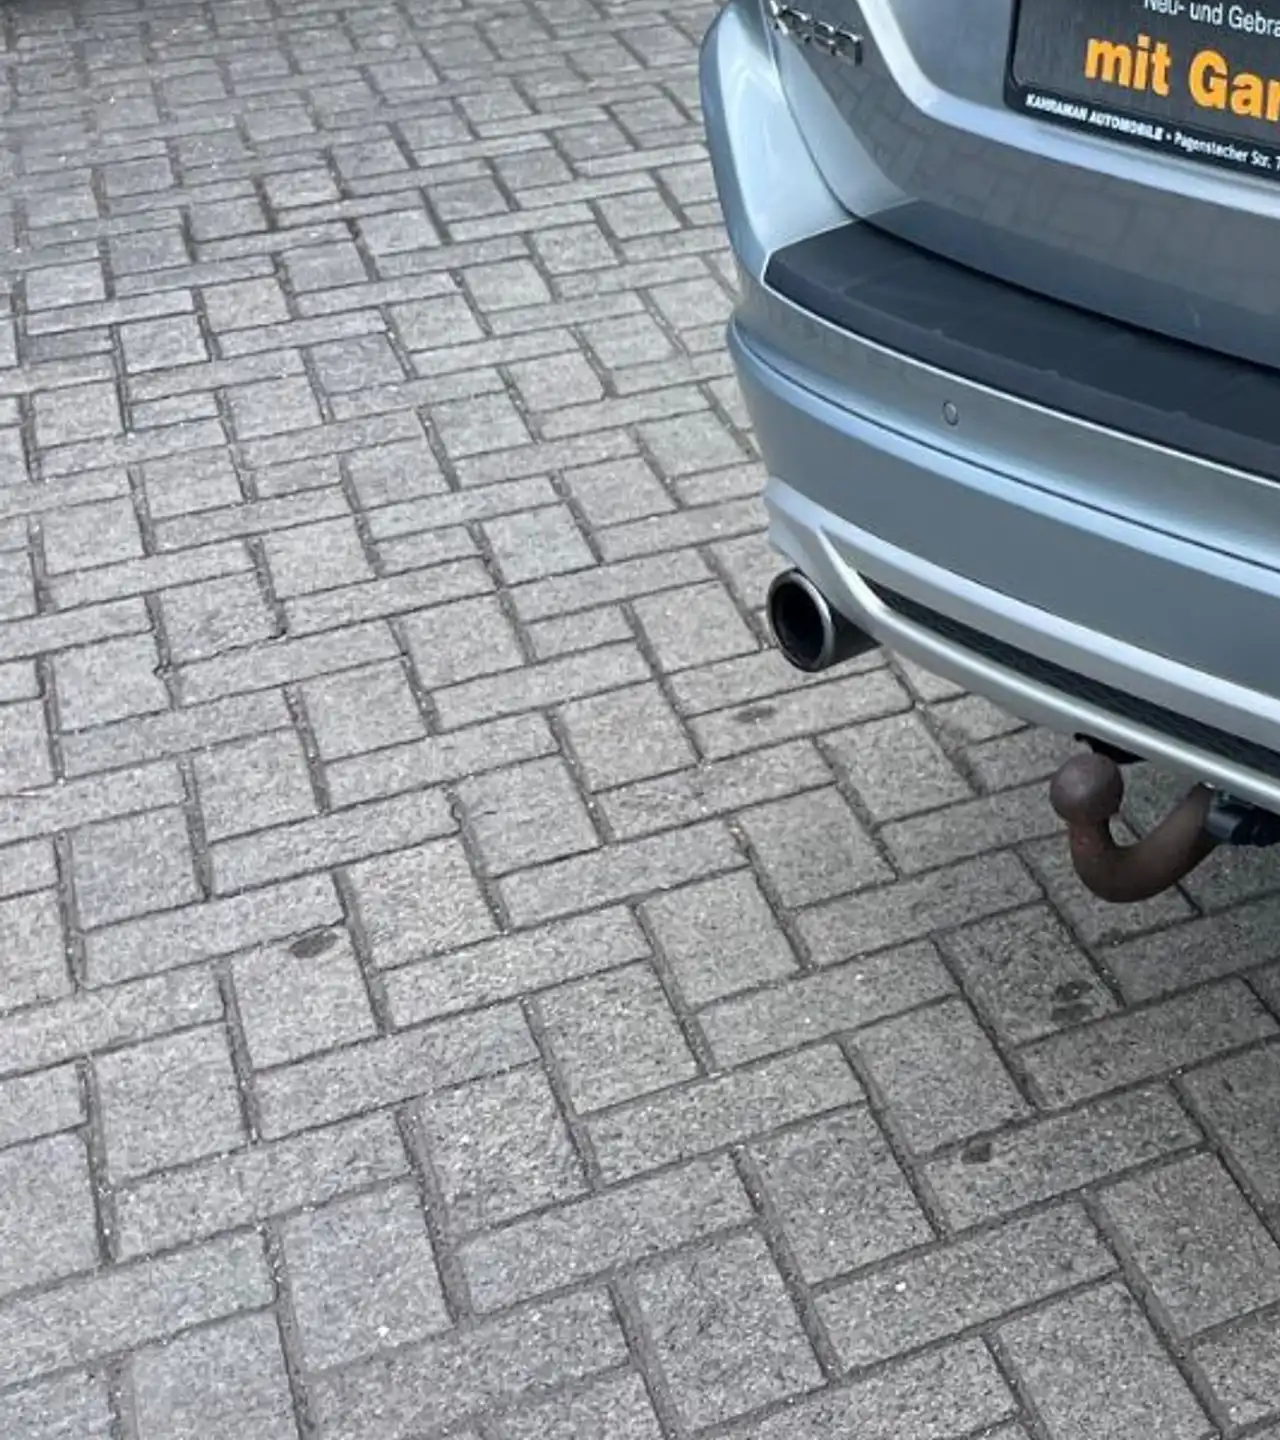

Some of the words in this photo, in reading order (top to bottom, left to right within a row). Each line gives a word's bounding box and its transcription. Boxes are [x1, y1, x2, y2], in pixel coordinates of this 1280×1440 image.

[1190, 2, 1223, 26] und
[1084, 32, 1172, 97] mit
[1025, 93, 1089, 122] KAHRAMAN
[1088, 110, 1164, 142] AUTOMOBILE
[1174, 131, 1250, 162] Pagenstecher
[1251, 150, 1272, 169] Str.
